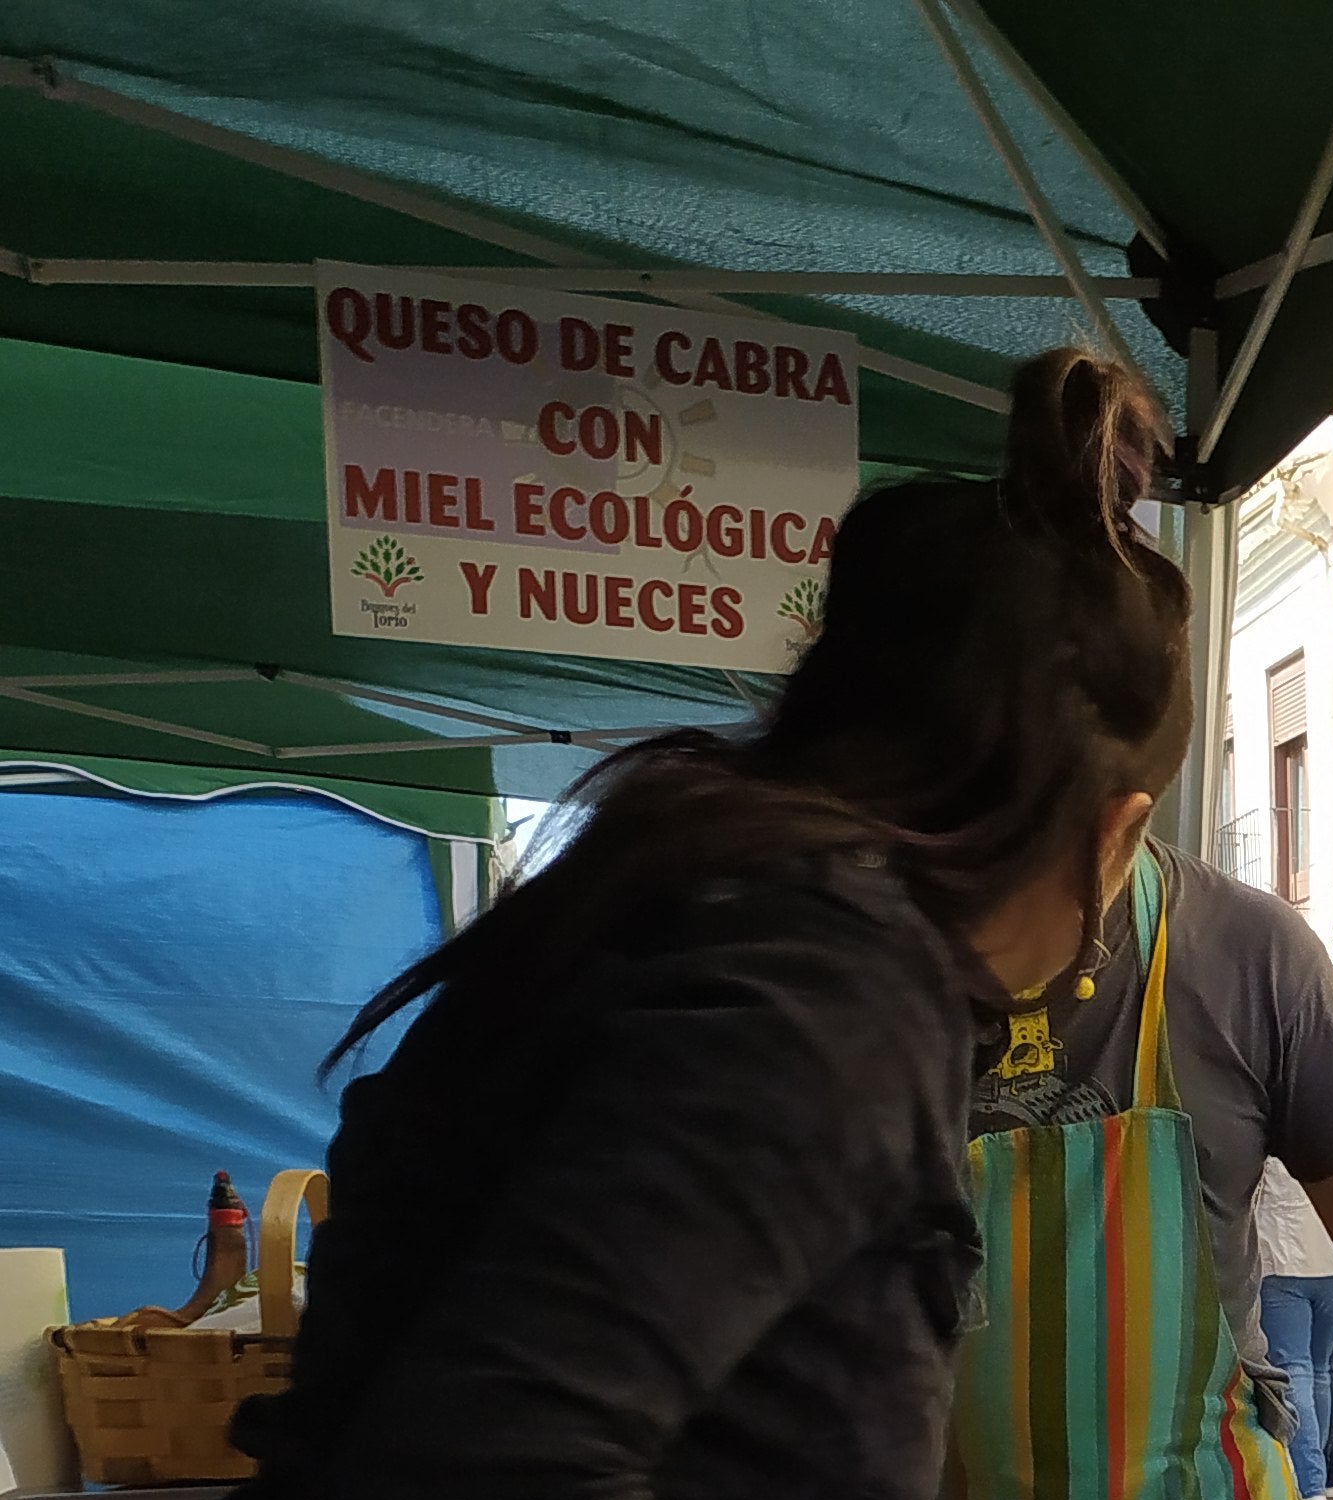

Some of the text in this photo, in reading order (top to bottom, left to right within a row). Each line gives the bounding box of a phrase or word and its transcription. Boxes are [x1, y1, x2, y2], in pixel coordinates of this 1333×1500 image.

[327, 287, 852, 406] QUESO DE CABRA
[538, 401, 662, 465] CON
[343, 464, 836, 566] MIEL ECOLÓGICA
[459, 561, 745, 639] Y NUECES
